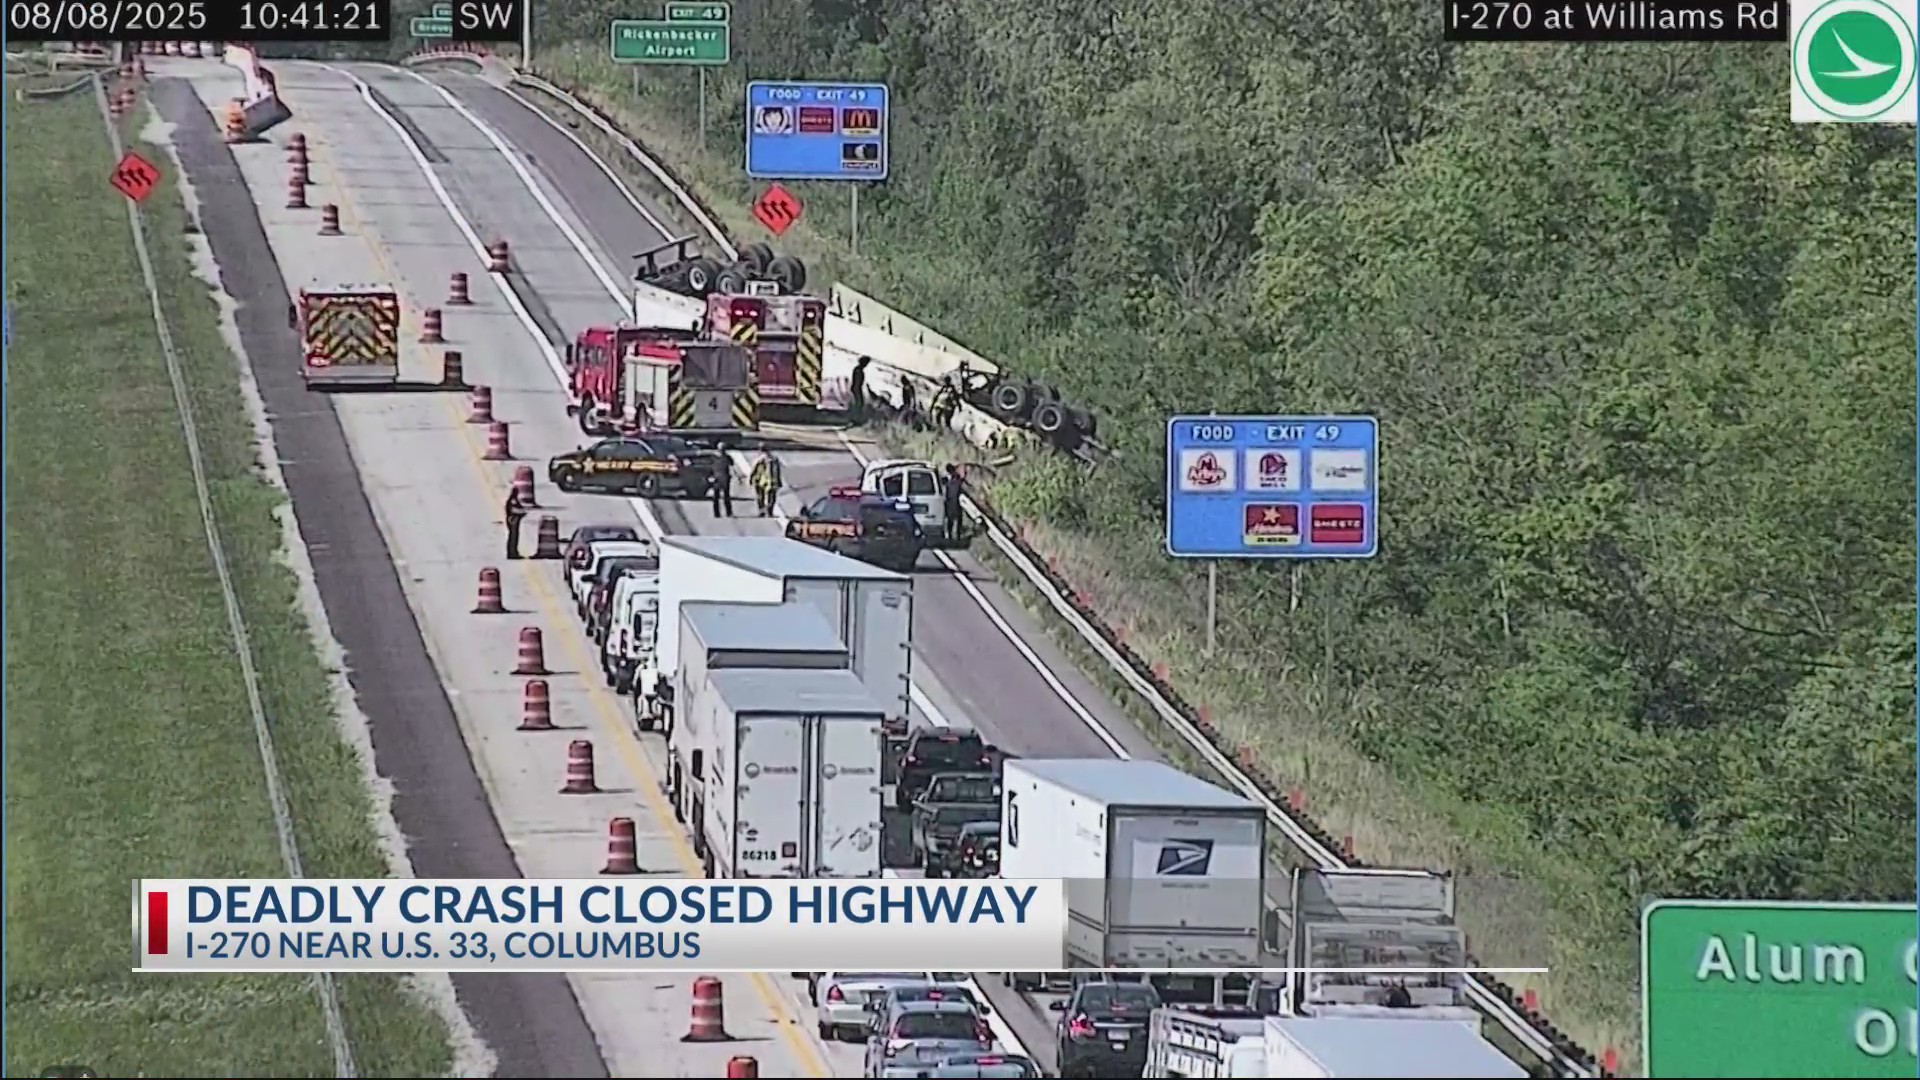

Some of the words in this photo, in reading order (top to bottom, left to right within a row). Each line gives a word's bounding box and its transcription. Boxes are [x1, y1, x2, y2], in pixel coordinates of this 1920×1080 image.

[672, 8, 694, 17] EXIT
[702, 7, 723, 18] 49
[622, 28, 717, 40] Rickenbacker
[645, 45, 695, 57] Airport
[768, 89, 801, 99] FOOD
[816, 90, 842, 100] EXIT
[849, 89, 866, 100] 49
[708, 397, 717, 410] 4
[1192, 426, 1233, 440] FOOD
[1267, 426, 1304, 440] EXIT
[1315, 426, 1339, 440] 49
[742, 850, 777, 861] 86218
[1697, 934, 1865, 983] Alum
